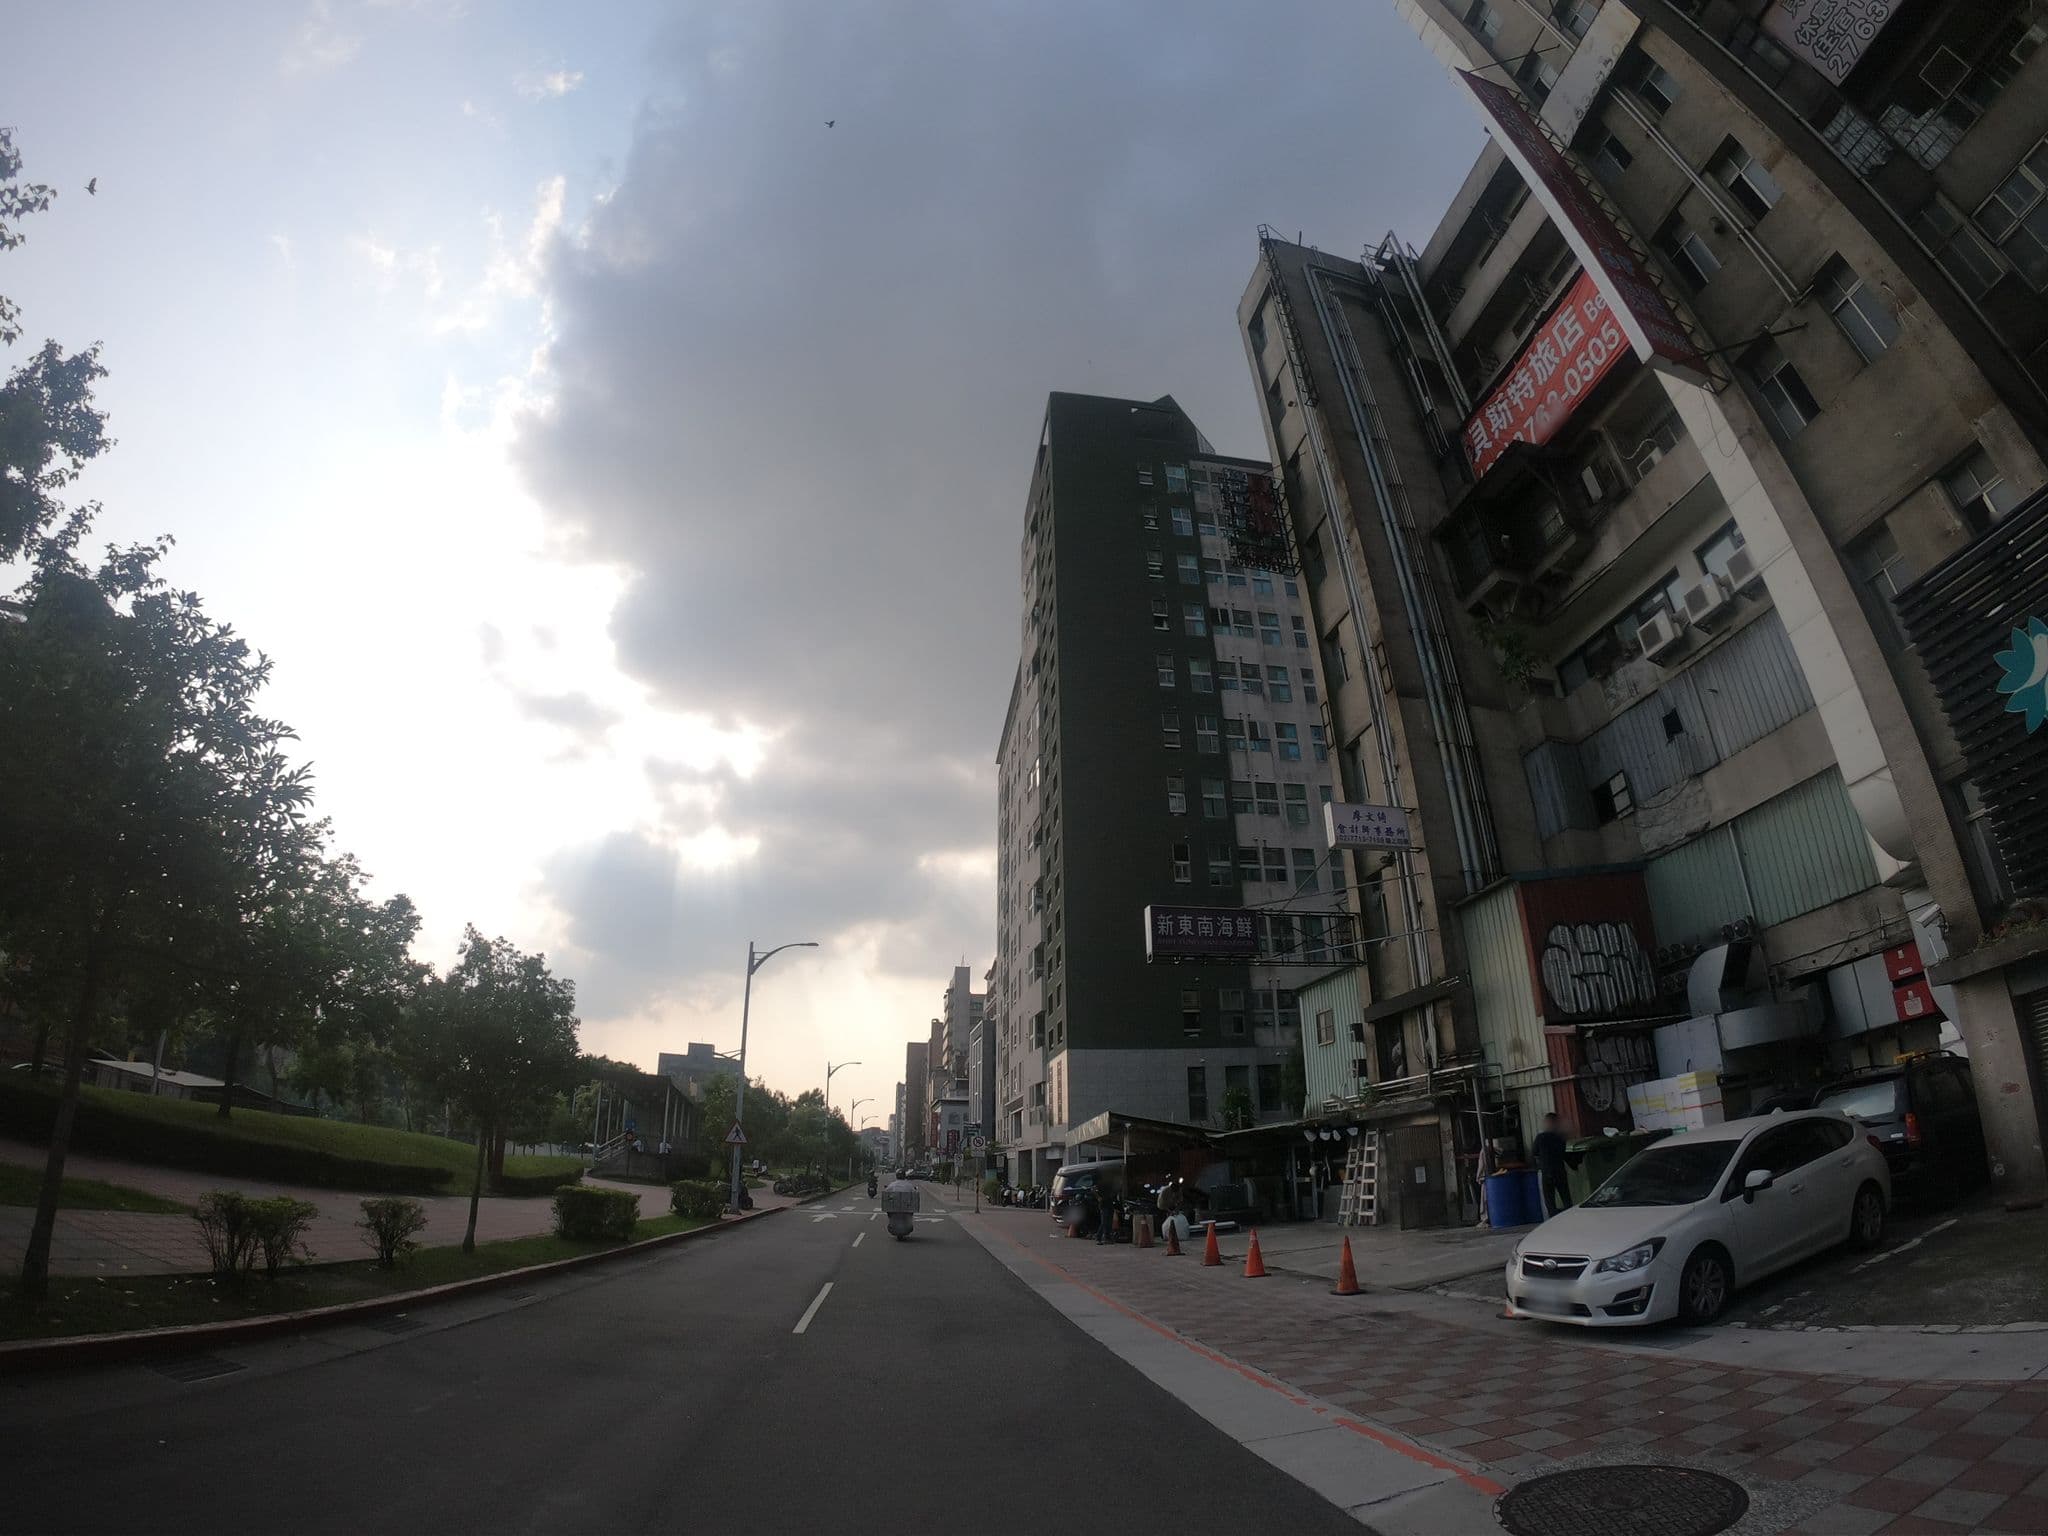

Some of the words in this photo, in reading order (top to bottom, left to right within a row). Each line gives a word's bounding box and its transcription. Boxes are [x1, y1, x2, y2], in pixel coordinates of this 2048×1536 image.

[1795, 0, 1838, 46] 休息
[1468, 304, 1585, 463] 貝斯特旅店
[1156, 913, 1254, 938] 新東南海鮮
